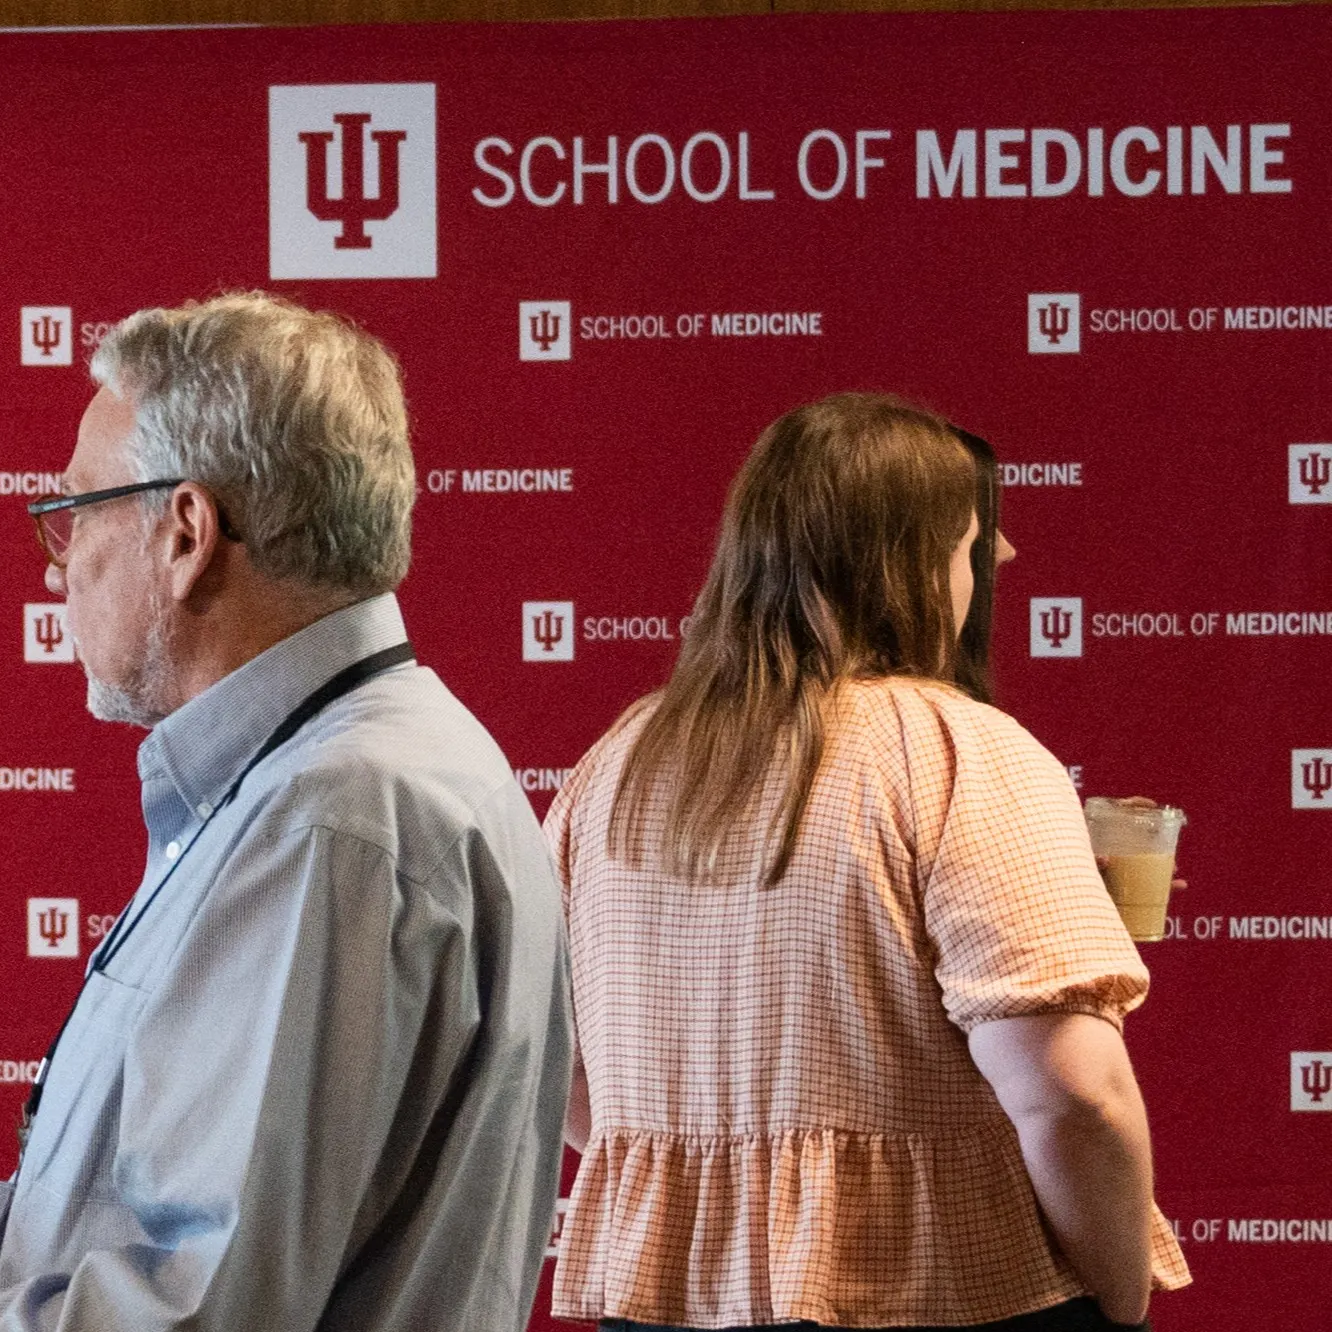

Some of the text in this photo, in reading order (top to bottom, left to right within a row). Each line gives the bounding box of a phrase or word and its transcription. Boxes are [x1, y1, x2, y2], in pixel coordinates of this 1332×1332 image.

[471, 130, 776, 208] SCHOOL
[797, 128, 892, 201] OF
[915, 122, 1293, 199] MEDICINE
[579, 314, 672, 341] SCHOOL
[675, 313, 705, 338] OF
[711, 312, 823, 337] MEDICINE
[1089, 307, 1184, 333] SCHOOL
[1187, 307, 1219, 332] OF
[426, 467, 574, 494] OF MEDICINE
[997, 462, 1083, 487] DICINE
[583, 616, 675, 641] SCHOOL
[1091, 612, 1185, 638] SCHOOL
[1190, 612, 1220, 637] OF
[1193, 916, 1224, 940] OF
[1228, 915, 1332, 940] MEDICIN
[1192, 1218, 1223, 1243] OF
[1227, 1218, 1332, 1243] MEDICIN
